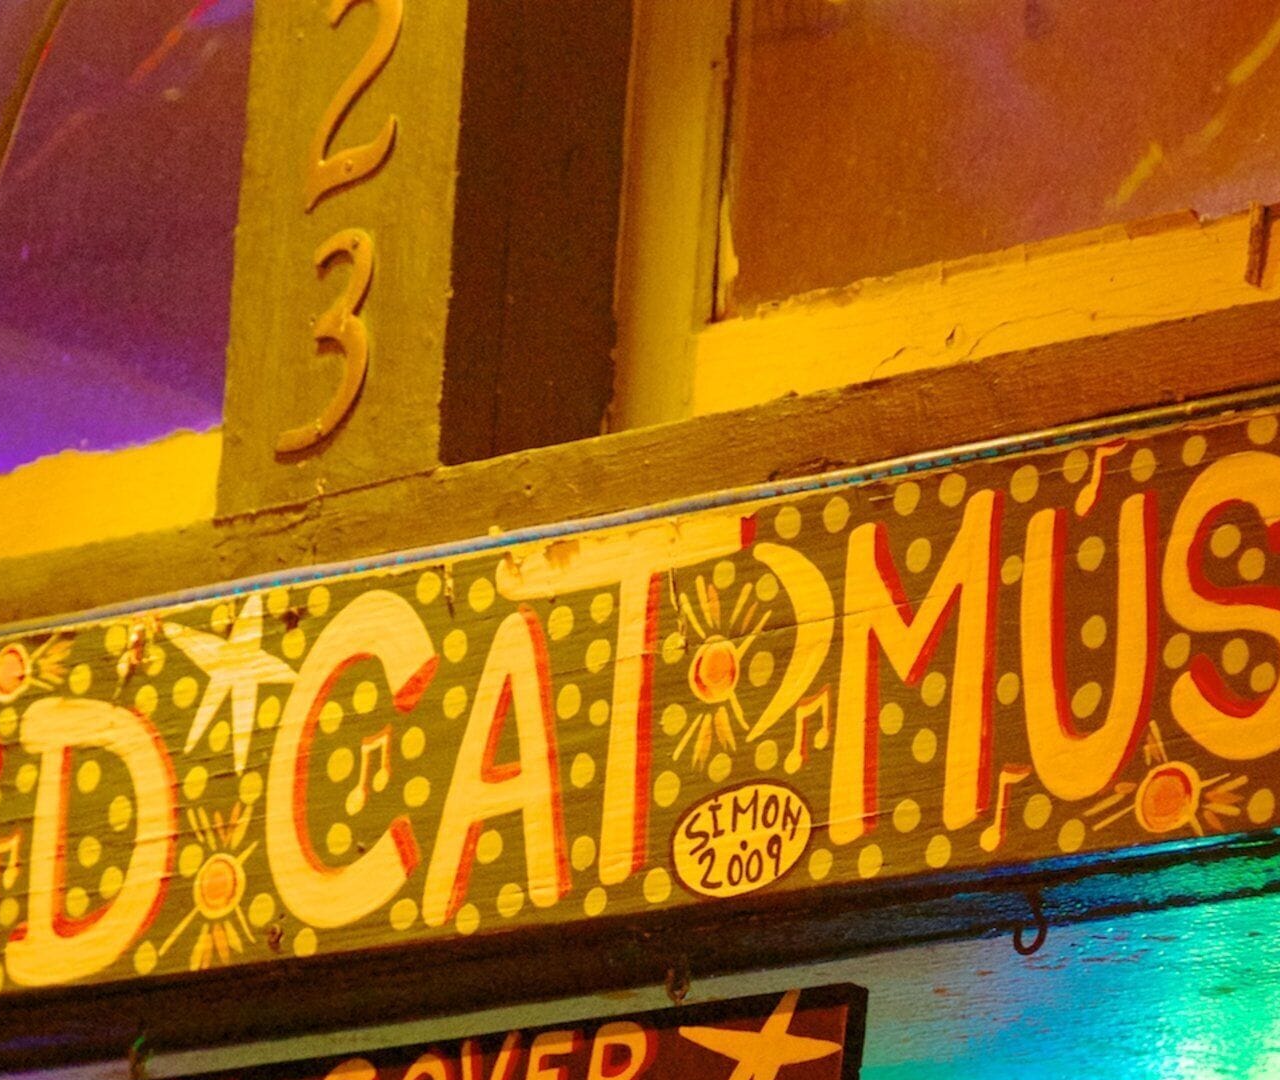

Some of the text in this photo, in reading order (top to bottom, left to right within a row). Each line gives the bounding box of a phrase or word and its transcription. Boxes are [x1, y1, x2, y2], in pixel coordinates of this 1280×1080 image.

[266, 516, 755, 927] CAT
[685, 789, 802, 856] SIMON
[698, 834, 783, 889] 2009
